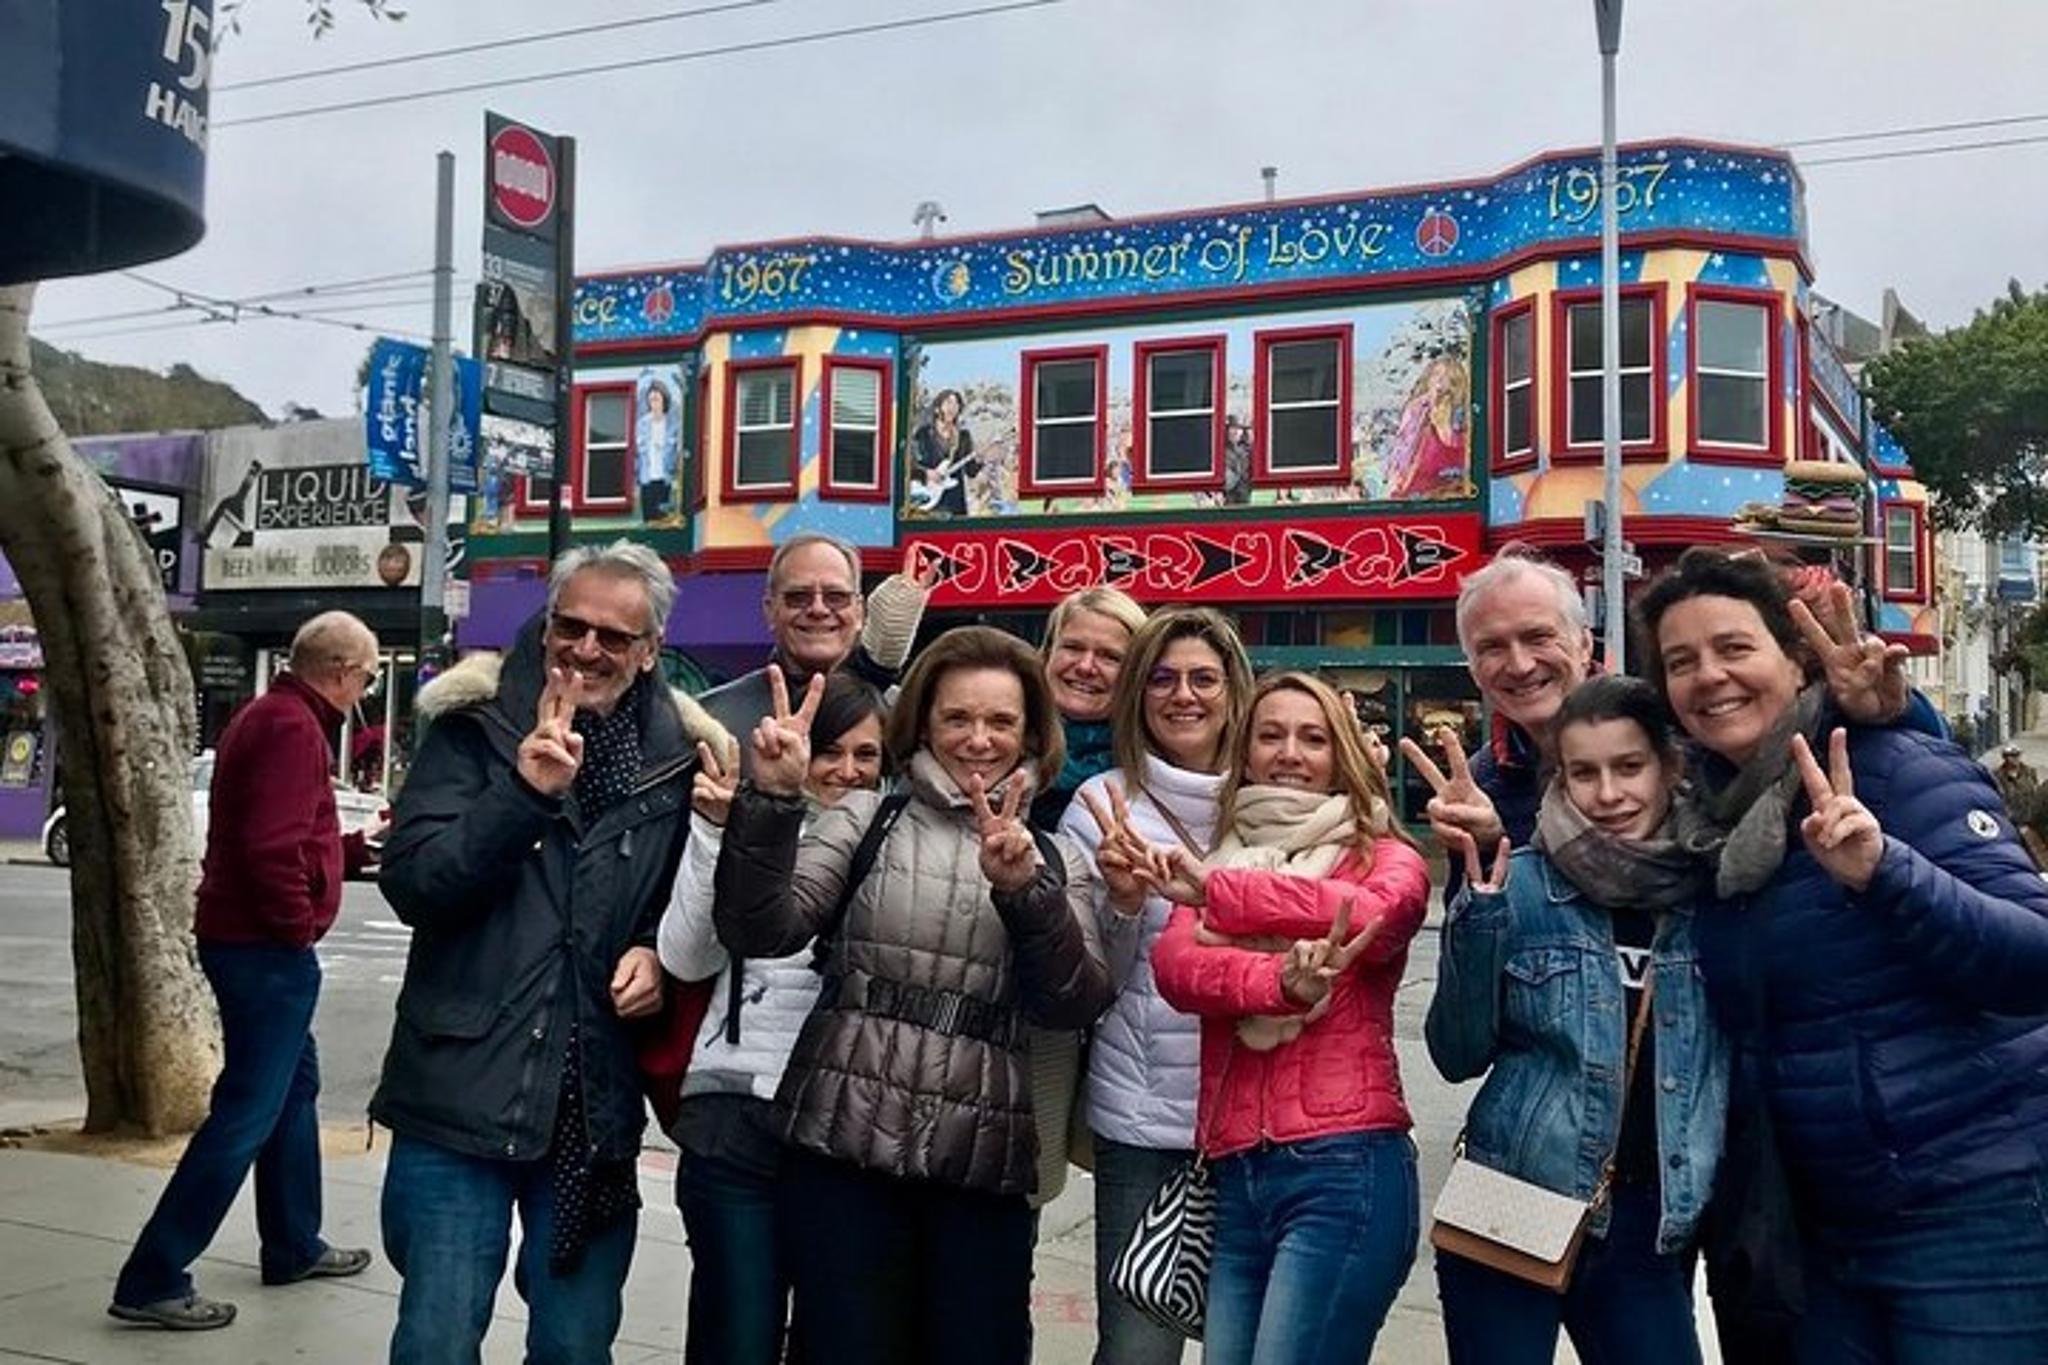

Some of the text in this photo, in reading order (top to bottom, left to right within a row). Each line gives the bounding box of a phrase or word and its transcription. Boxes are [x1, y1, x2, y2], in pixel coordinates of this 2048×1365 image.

[1547, 163, 1670, 224] 1967
[721, 257, 813, 304] 1967
[1004, 222, 1386, 295] Summer of Love
[261, 466, 384, 506] LIQUID
[258, 501, 386, 527] EXPERIENCE
[1232, 523, 1468, 591] URGE
